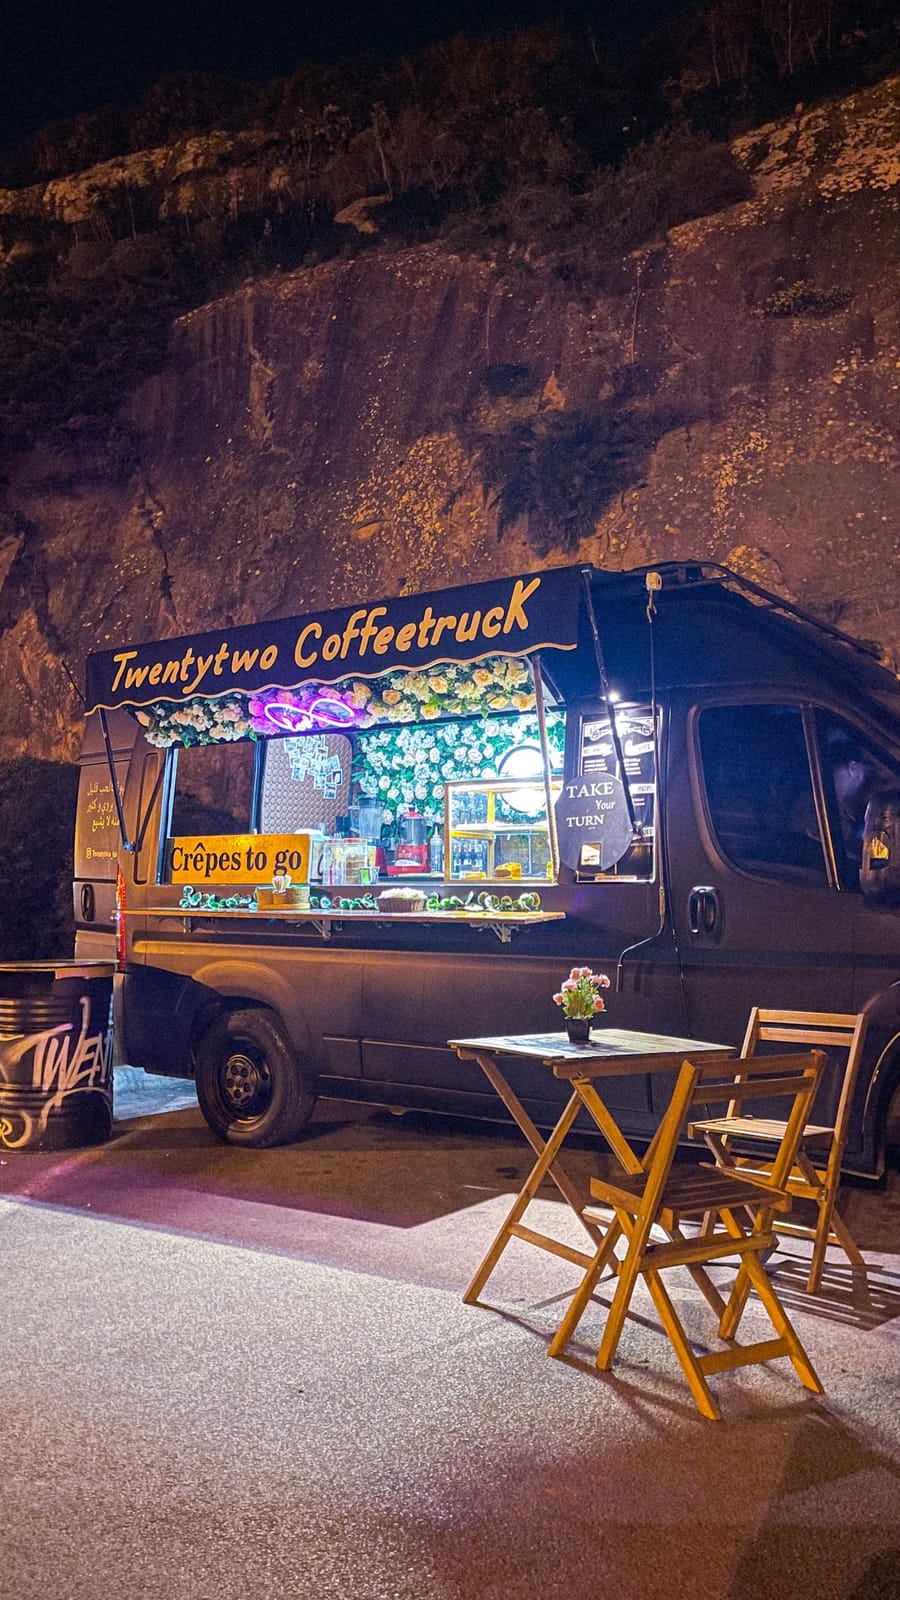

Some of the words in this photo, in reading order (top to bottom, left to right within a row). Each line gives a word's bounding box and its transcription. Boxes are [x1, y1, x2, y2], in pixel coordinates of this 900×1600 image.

[111, 642, 278, 694] Twentytwo
[566, 783, 614, 799] TAKE
[595, 799, 616, 810] Your
[566, 815, 605, 828] TURN
[171, 842, 241, 877] Crêpes
[246, 846, 267, 871] to
[273, 848, 301, 877] go
